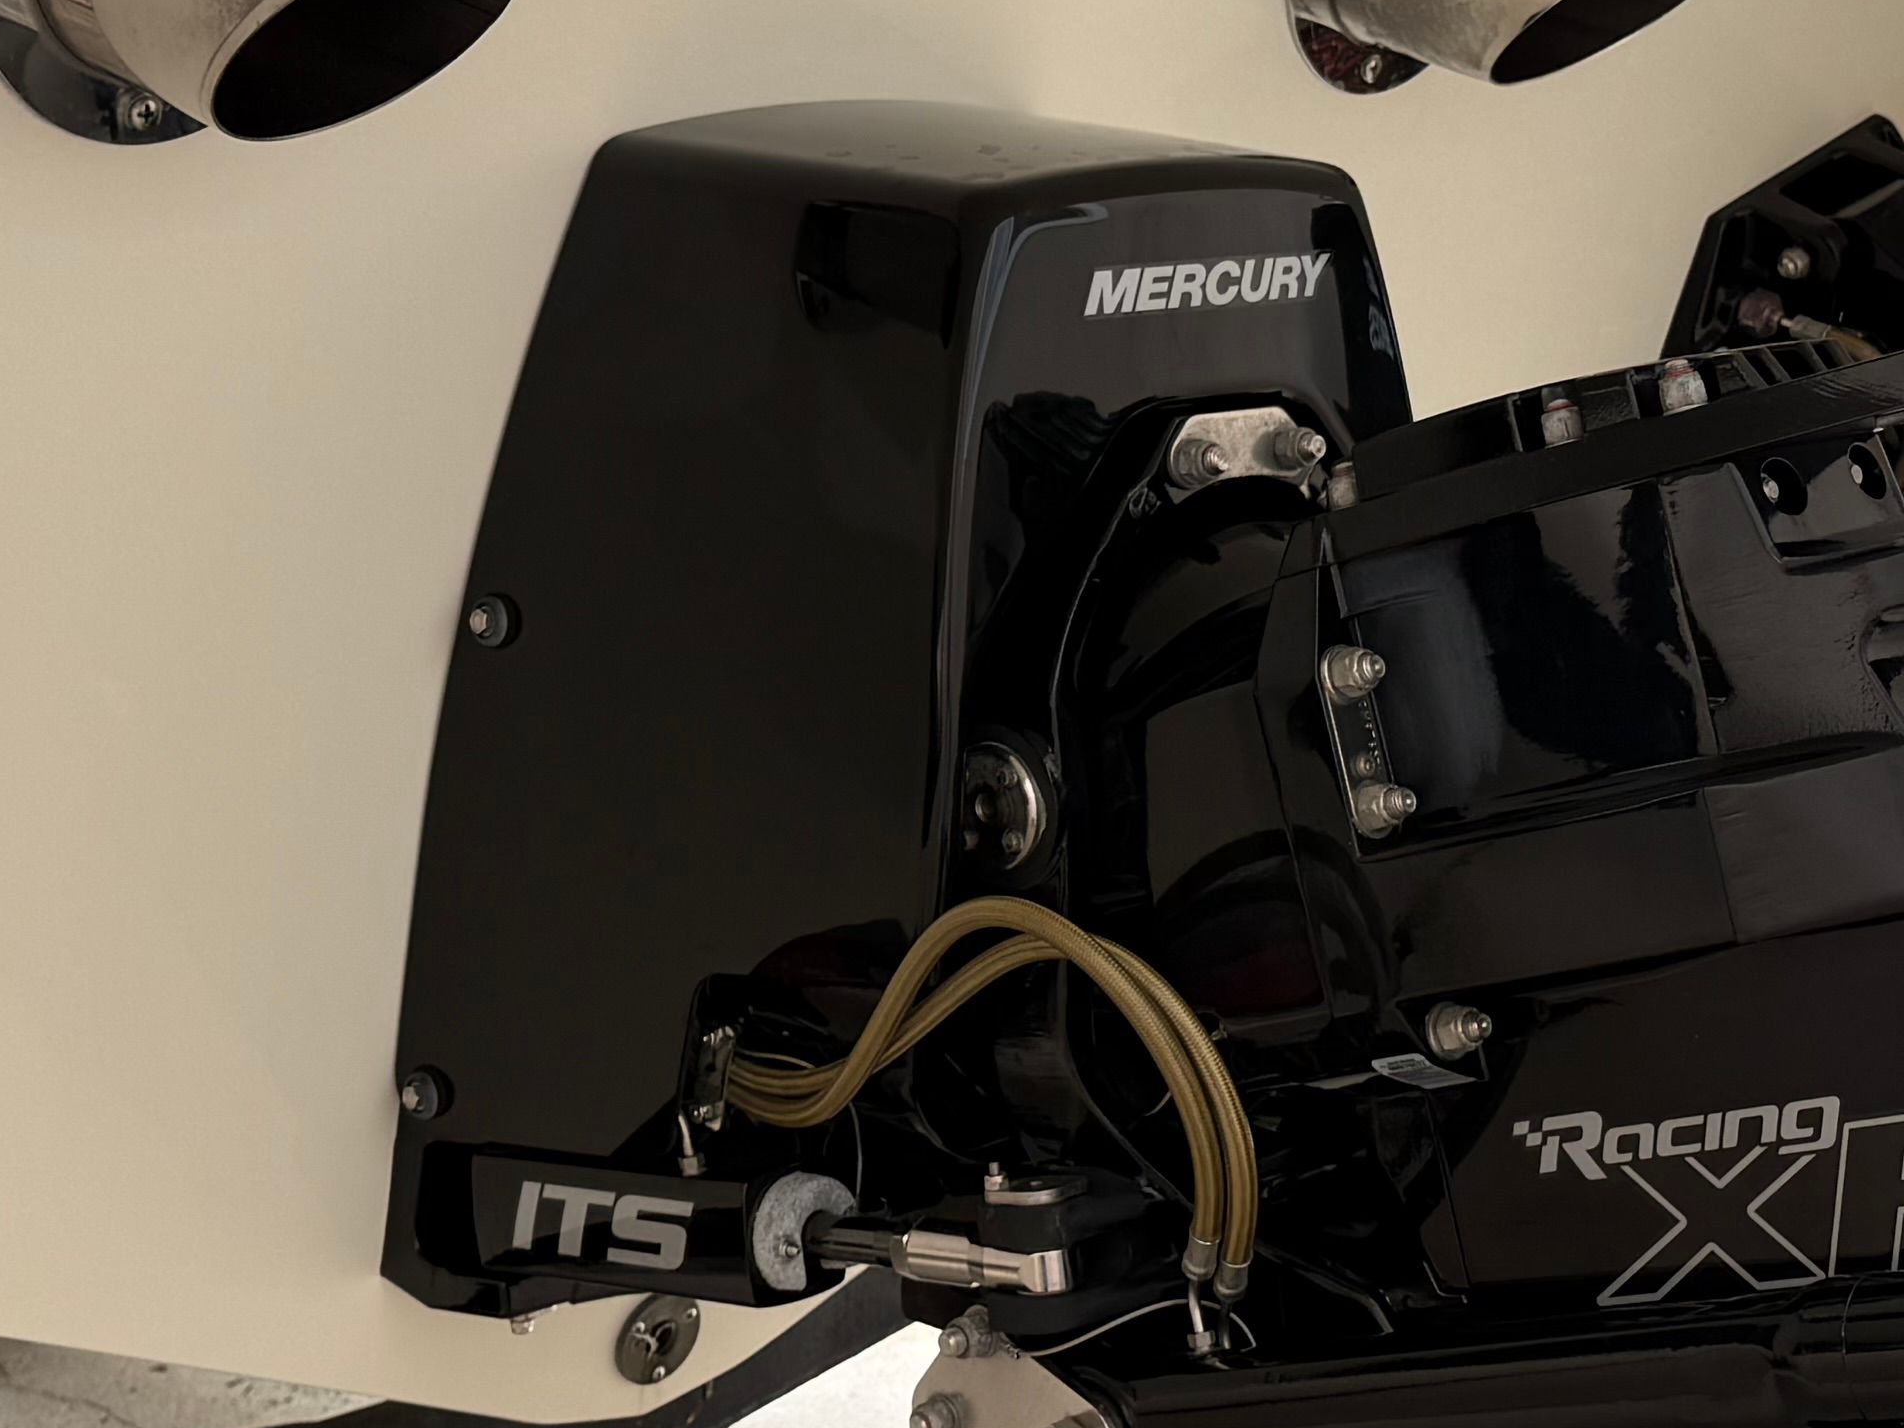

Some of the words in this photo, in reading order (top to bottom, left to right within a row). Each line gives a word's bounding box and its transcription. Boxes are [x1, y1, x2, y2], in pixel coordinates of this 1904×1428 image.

[1083, 252, 1331, 317] MERCURY
[1539, 1095, 1841, 1180] Racing
[511, 1180, 695, 1271] ITS
